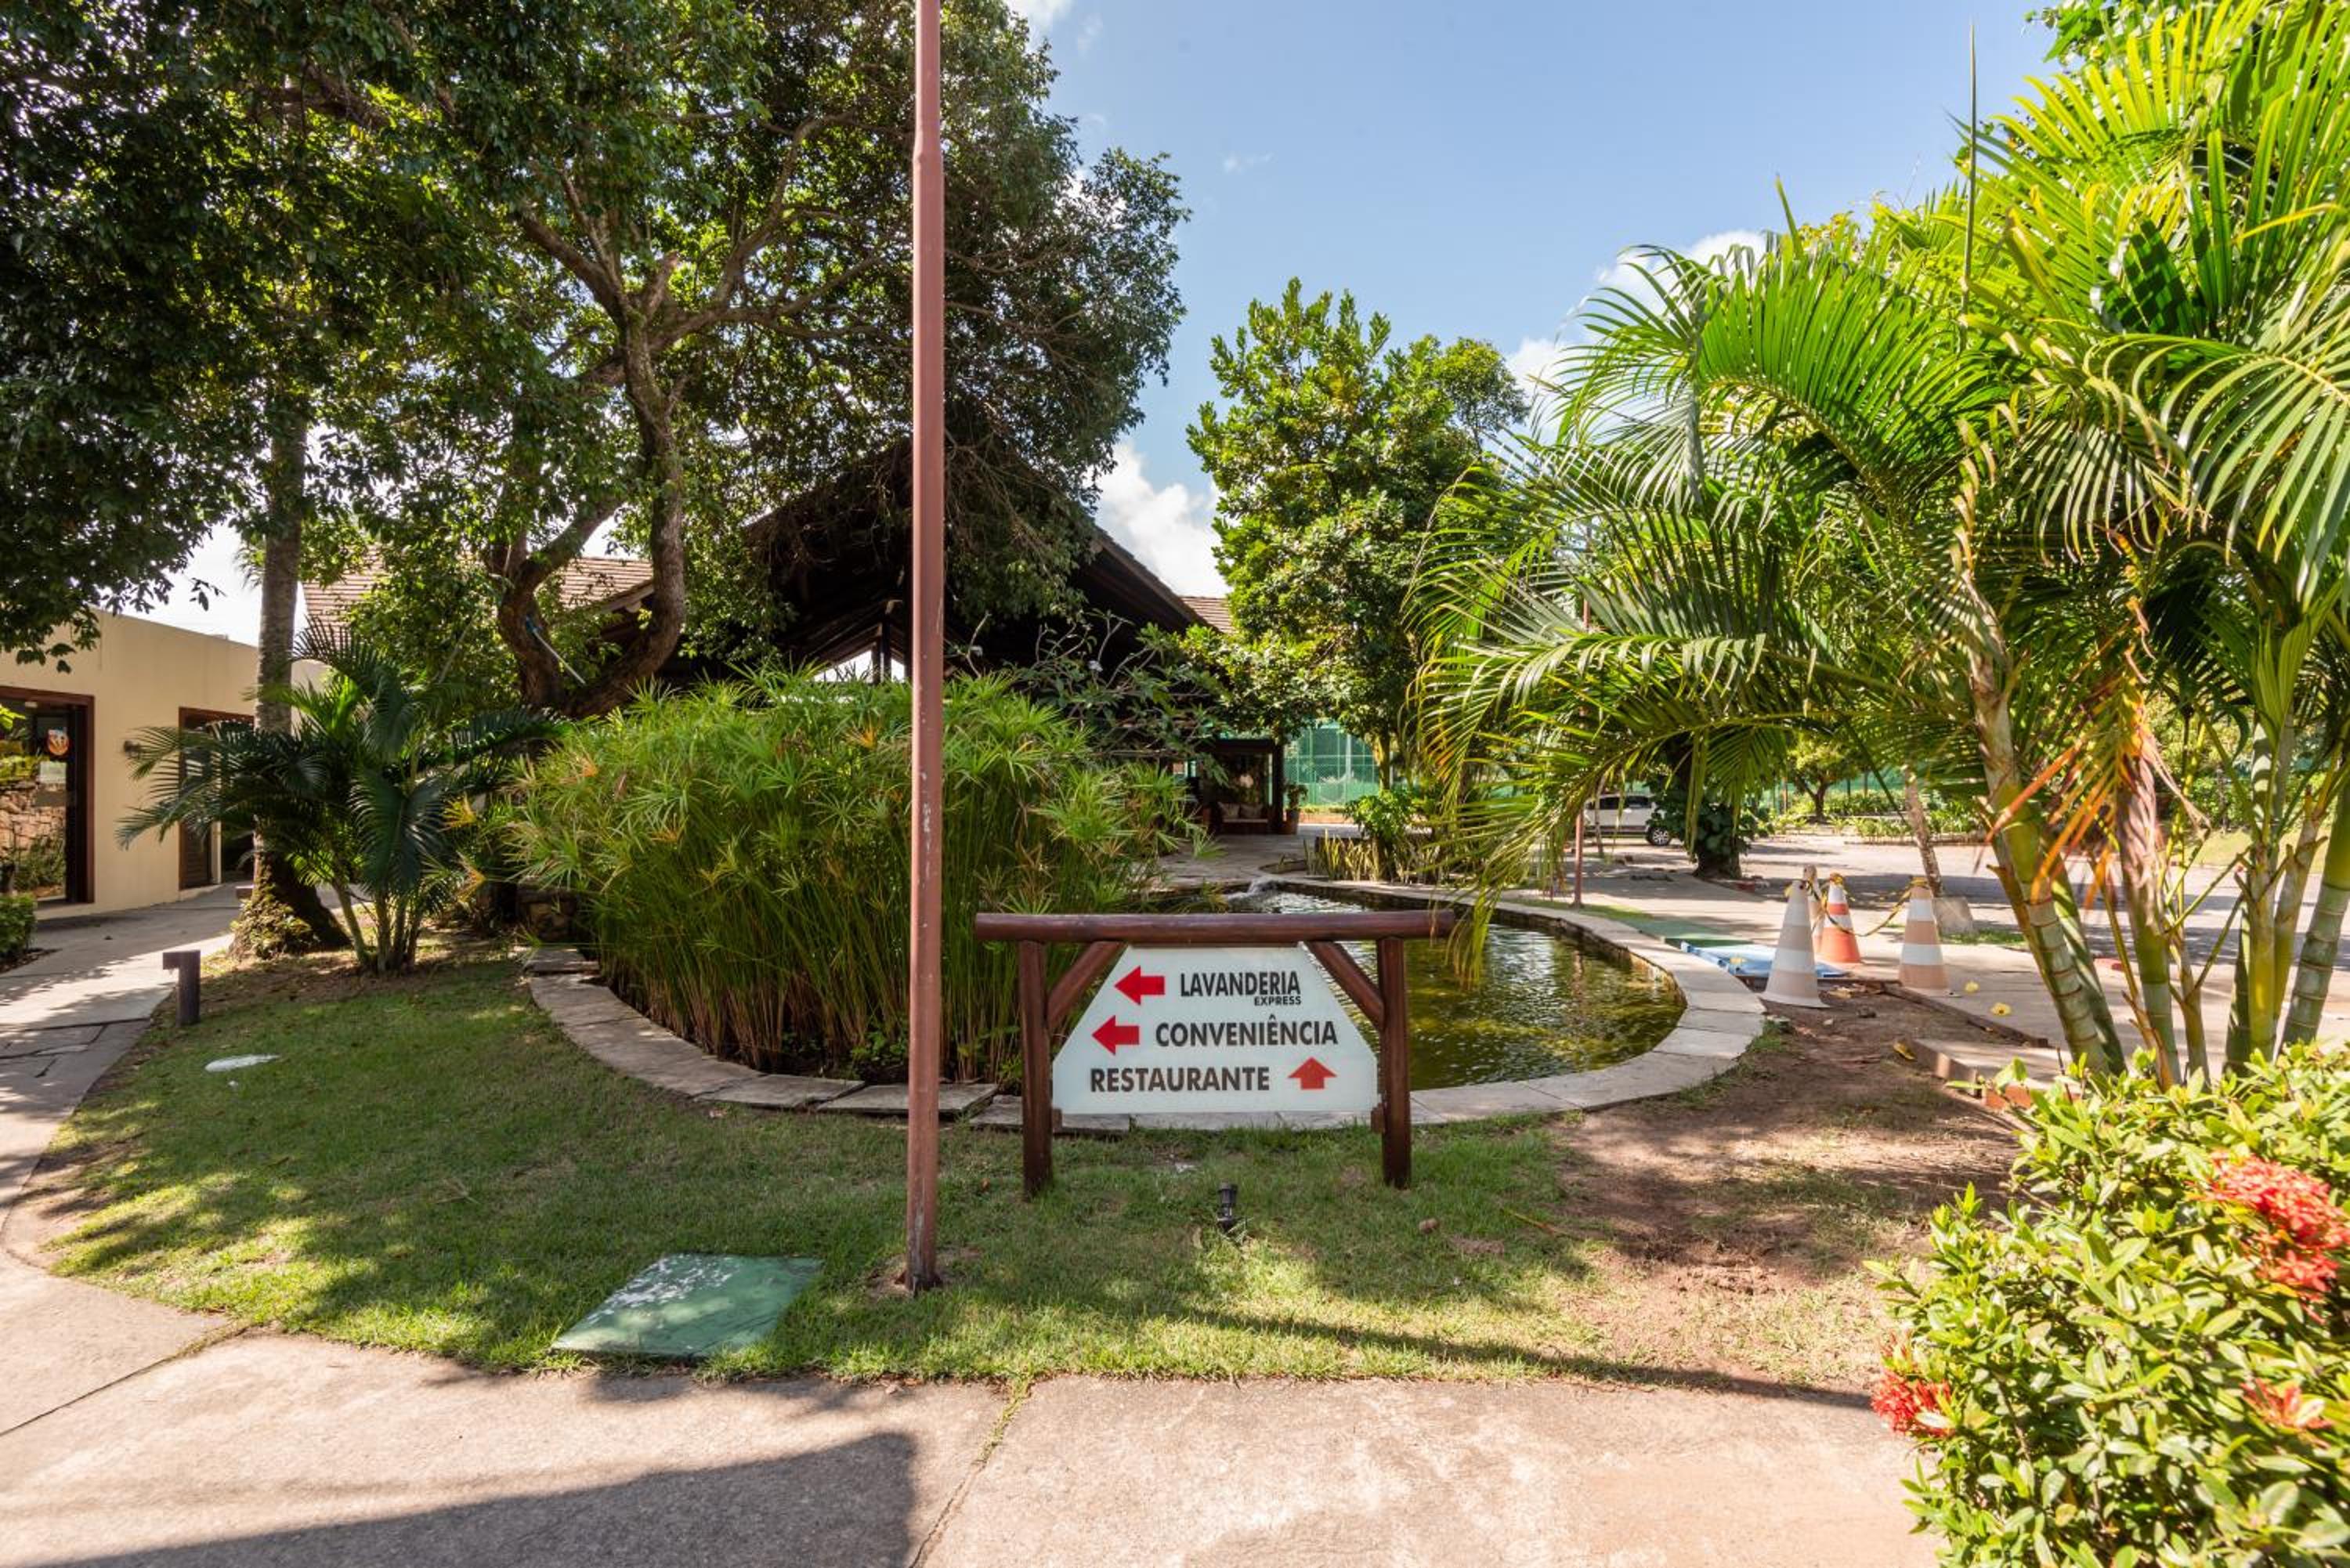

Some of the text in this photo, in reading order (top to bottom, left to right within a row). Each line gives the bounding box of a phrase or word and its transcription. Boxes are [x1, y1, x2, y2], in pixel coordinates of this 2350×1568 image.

[1180, 970, 1301, 997] LAVANDERIA
[1253, 995, 1302, 1006] EXPRESS
[1155, 1013, 1339, 1047] CONVENIÊNCIA
[1090, 1066, 1270, 1093] RESTAURANTE
